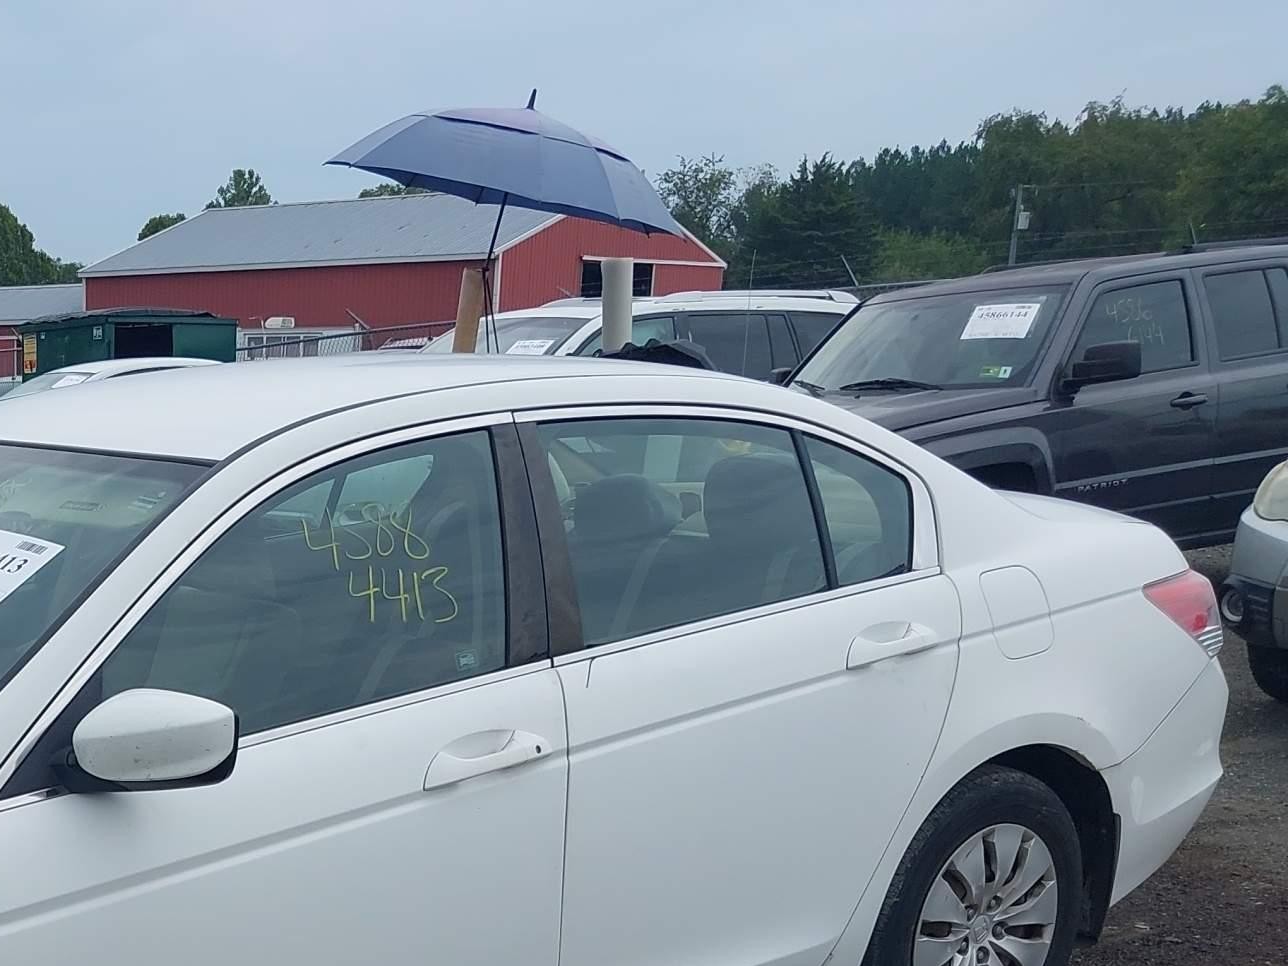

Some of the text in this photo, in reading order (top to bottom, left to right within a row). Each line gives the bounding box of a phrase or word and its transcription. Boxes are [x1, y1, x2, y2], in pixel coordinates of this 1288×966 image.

[977, 311, 1029, 319] 45866144
[1076, 478, 1128, 493] PATRIOT
[301, 503, 430, 571] 4588
[349, 564, 458, 623] 4413
